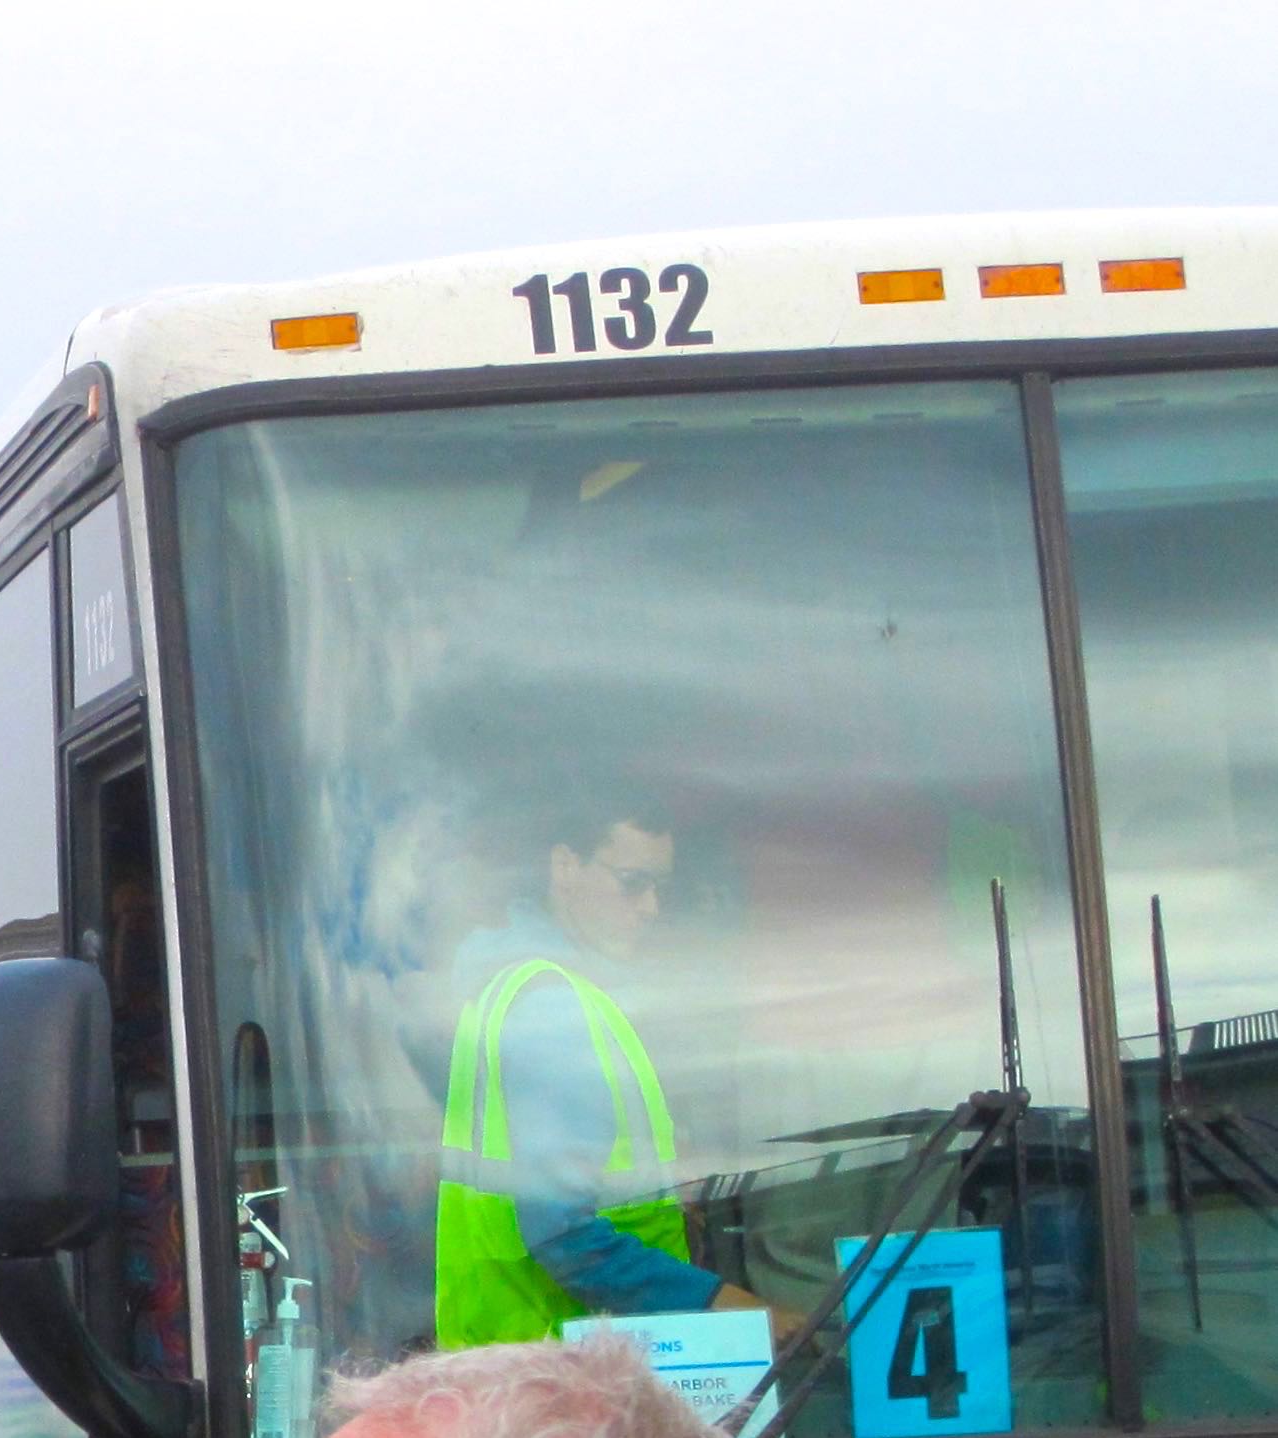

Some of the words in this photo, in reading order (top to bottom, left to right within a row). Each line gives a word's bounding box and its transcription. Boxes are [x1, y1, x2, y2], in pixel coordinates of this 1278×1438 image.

[512, 263, 714, 355] 1132
[669, 1377, 727, 1392] ARBOR
[887, 1285, 968, 1420] 4
